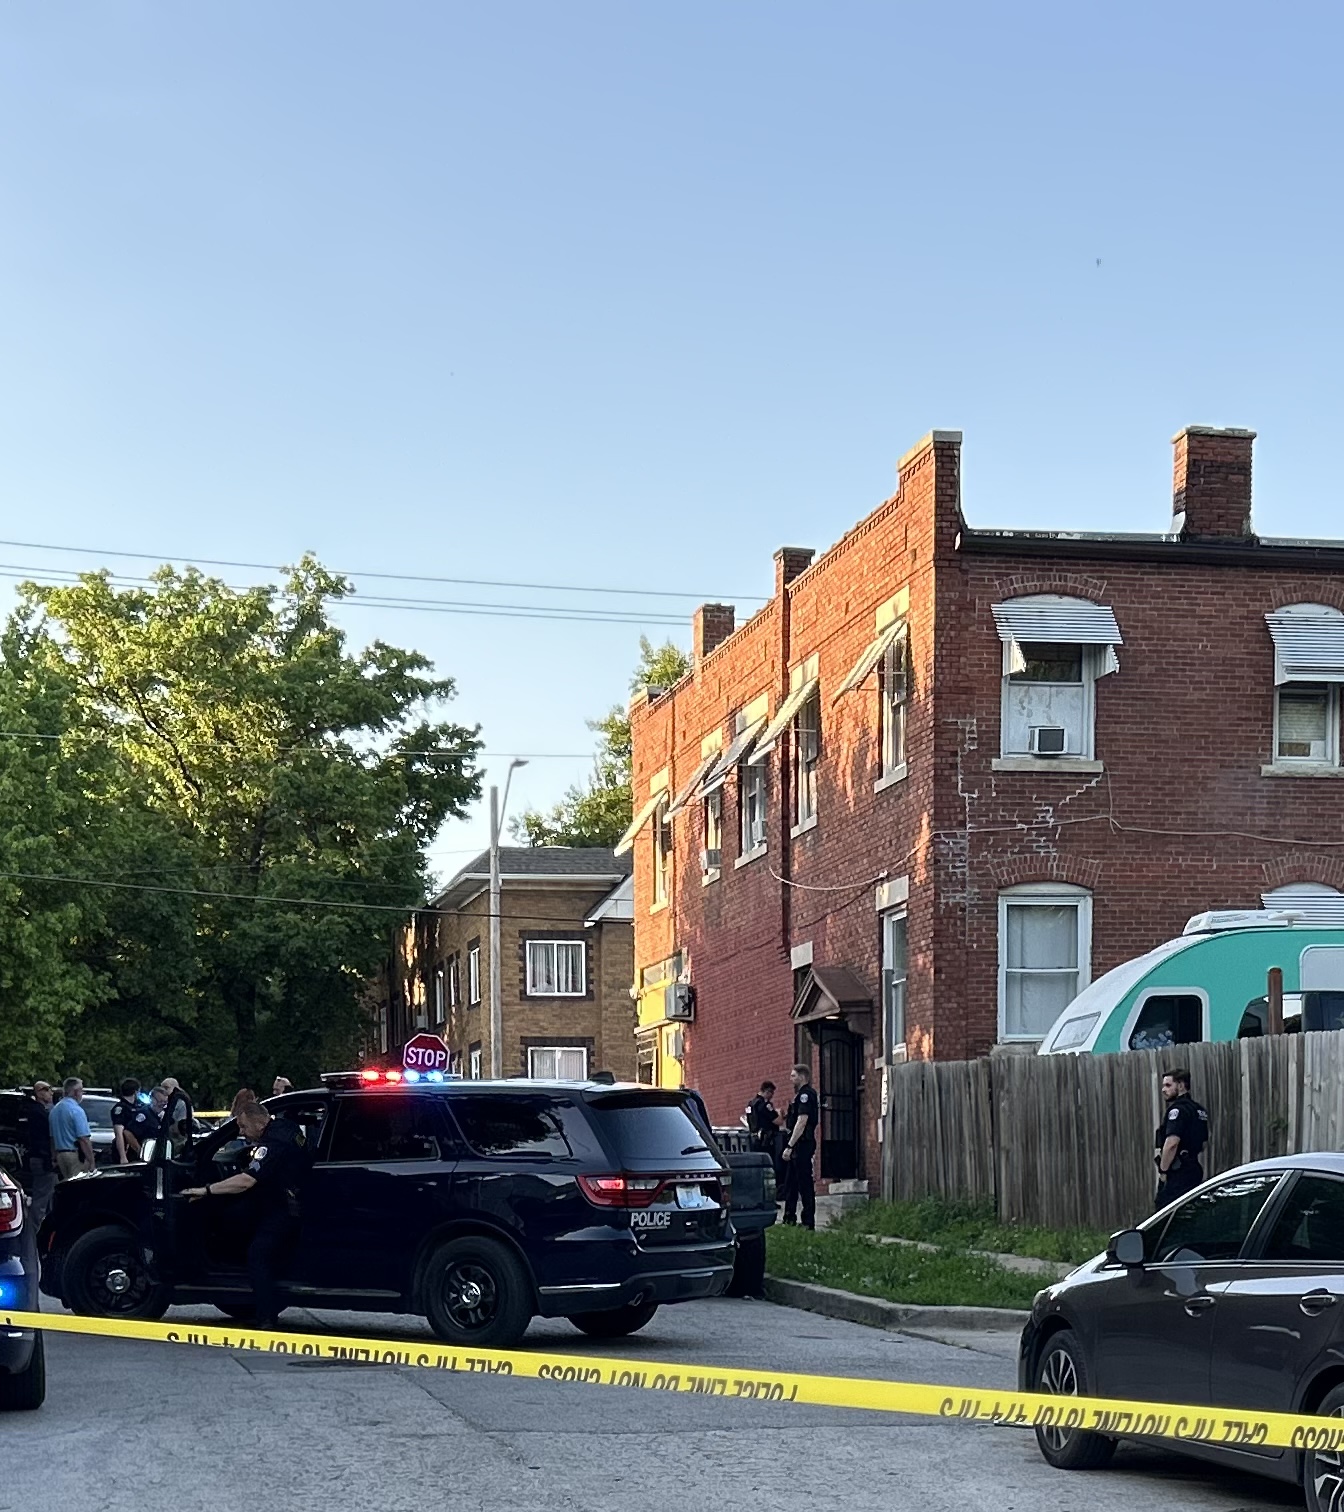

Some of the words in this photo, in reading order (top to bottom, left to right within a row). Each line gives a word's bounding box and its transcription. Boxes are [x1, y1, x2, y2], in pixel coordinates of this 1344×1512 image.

[407, 1047, 446, 1067] STOP
[630, 1212, 671, 1226] POLICE
[1092, 1410, 1171, 1437] HOTLINE
[1221, 1420, 1268, 1445] CALL
